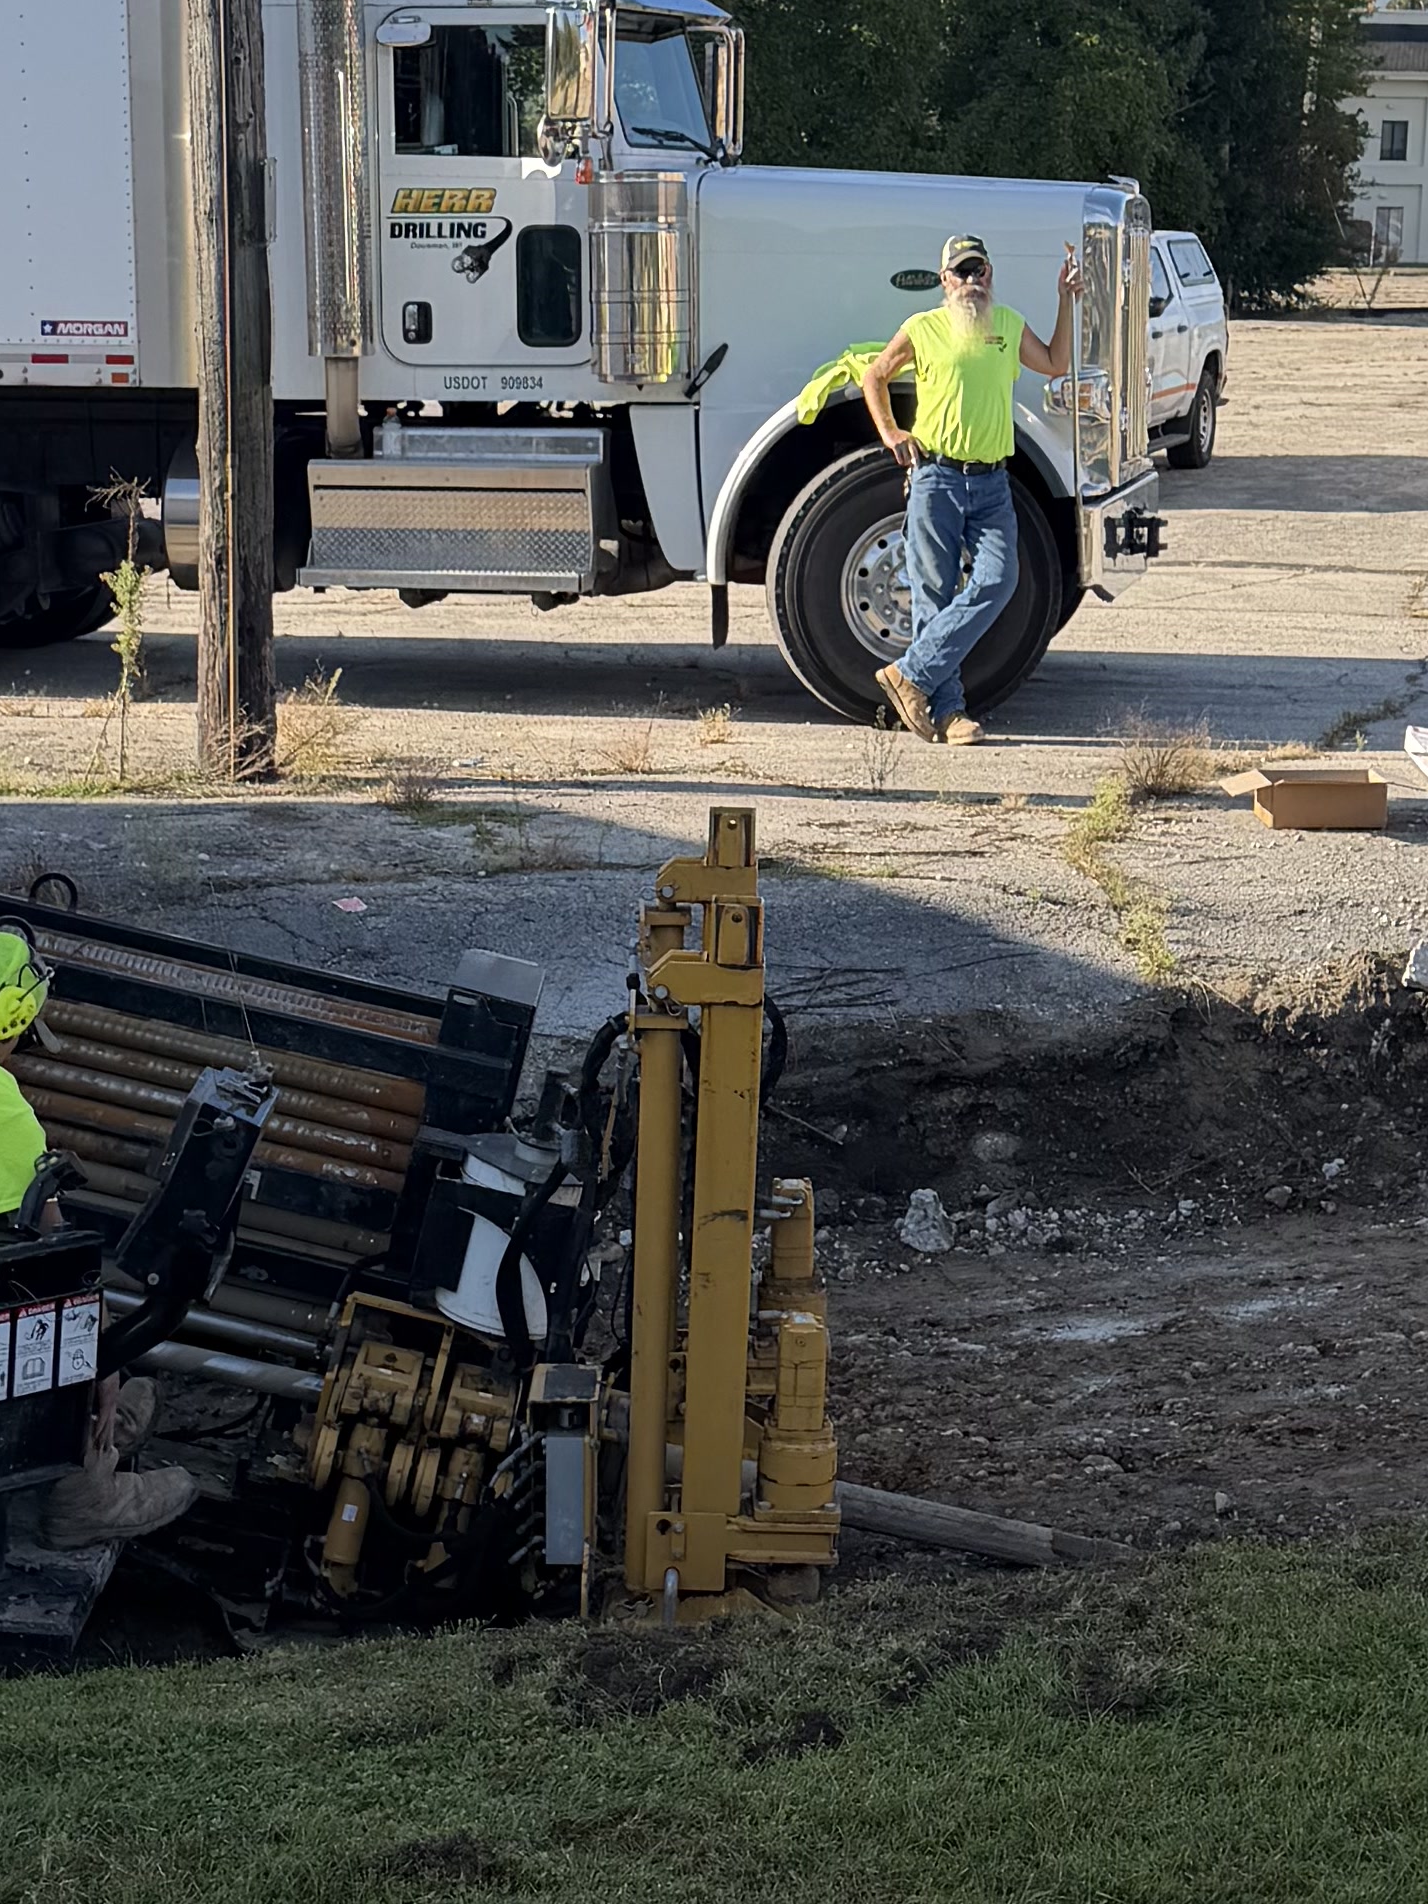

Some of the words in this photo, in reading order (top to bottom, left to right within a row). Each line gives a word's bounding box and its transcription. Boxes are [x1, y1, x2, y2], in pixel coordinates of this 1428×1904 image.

[391, 187, 497, 214] HERR
[389, 222, 488, 239] DRILLING
[56, 322, 125, 335] MORGAN
[443, 376, 488, 390] USDOT
